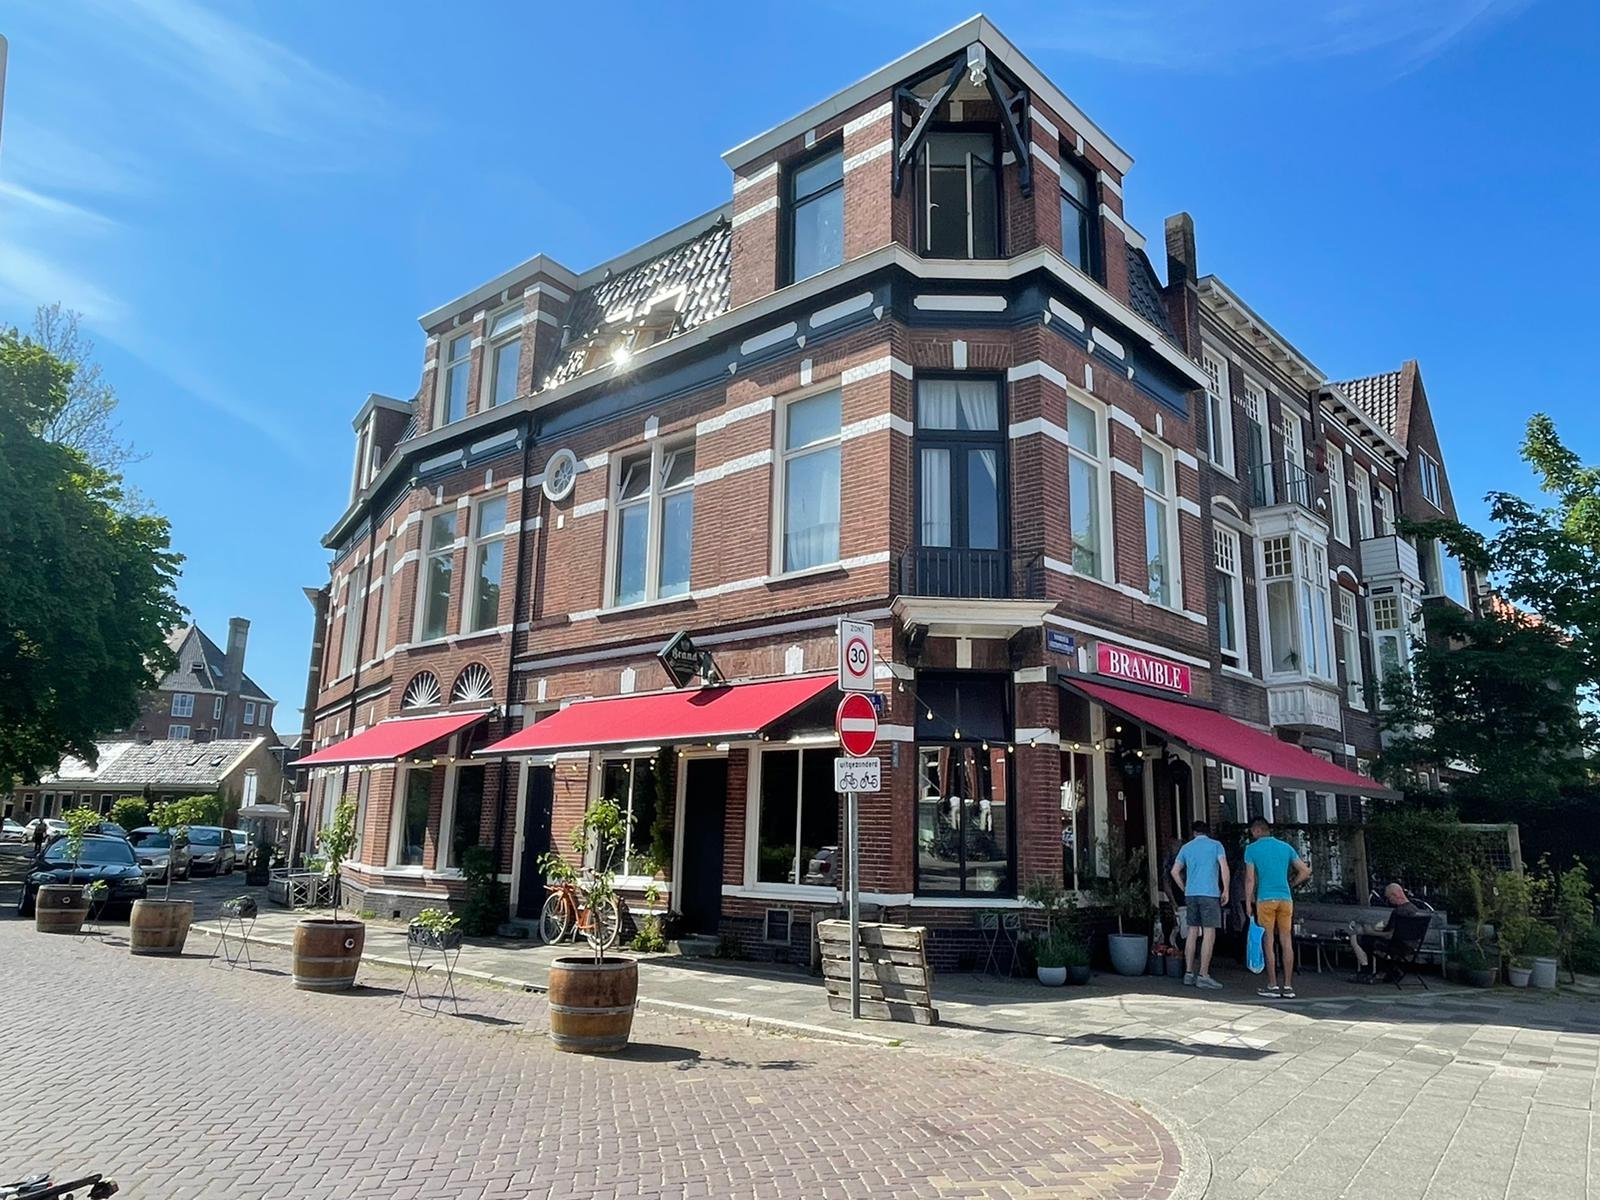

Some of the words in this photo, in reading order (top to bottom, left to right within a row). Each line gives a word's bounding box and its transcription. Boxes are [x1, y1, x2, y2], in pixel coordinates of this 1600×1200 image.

[850, 624, 865, 634] ZONE
[671, 648, 698, 661] Brand
[850, 648, 866, 664] 30
[1109, 650, 1182, 689] BRAMBLE
[839, 761, 878, 769] uitgezonderd
